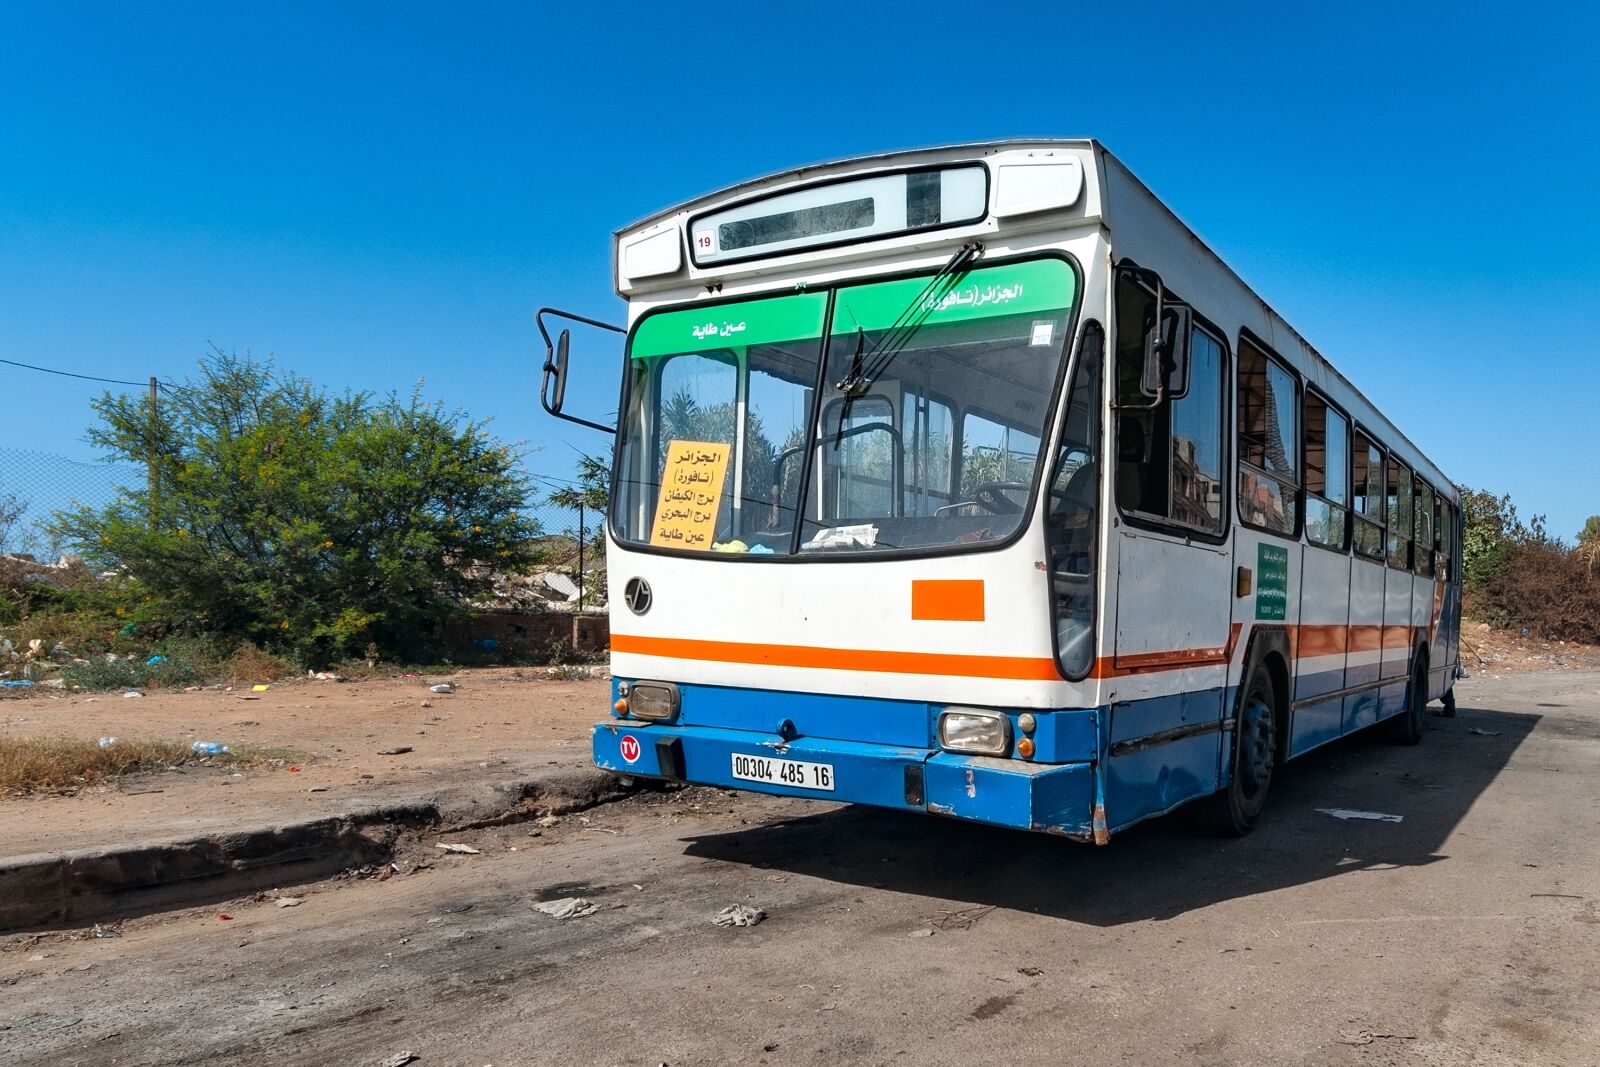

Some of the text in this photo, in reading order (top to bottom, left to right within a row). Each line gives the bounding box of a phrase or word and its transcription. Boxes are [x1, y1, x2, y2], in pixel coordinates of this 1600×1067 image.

[698, 236, 711, 248] 19
[691, 321, 747, 340] عين طاية
[675, 450, 721, 466] الجزائر
[664, 488, 715, 506] برج الكيفان
[661, 508, 711, 523] برج البحري
[659, 528, 705, 545] عين طاية
[622, 741, 637, 755] TV
[735, 756, 829, 787] 00304 485 16
